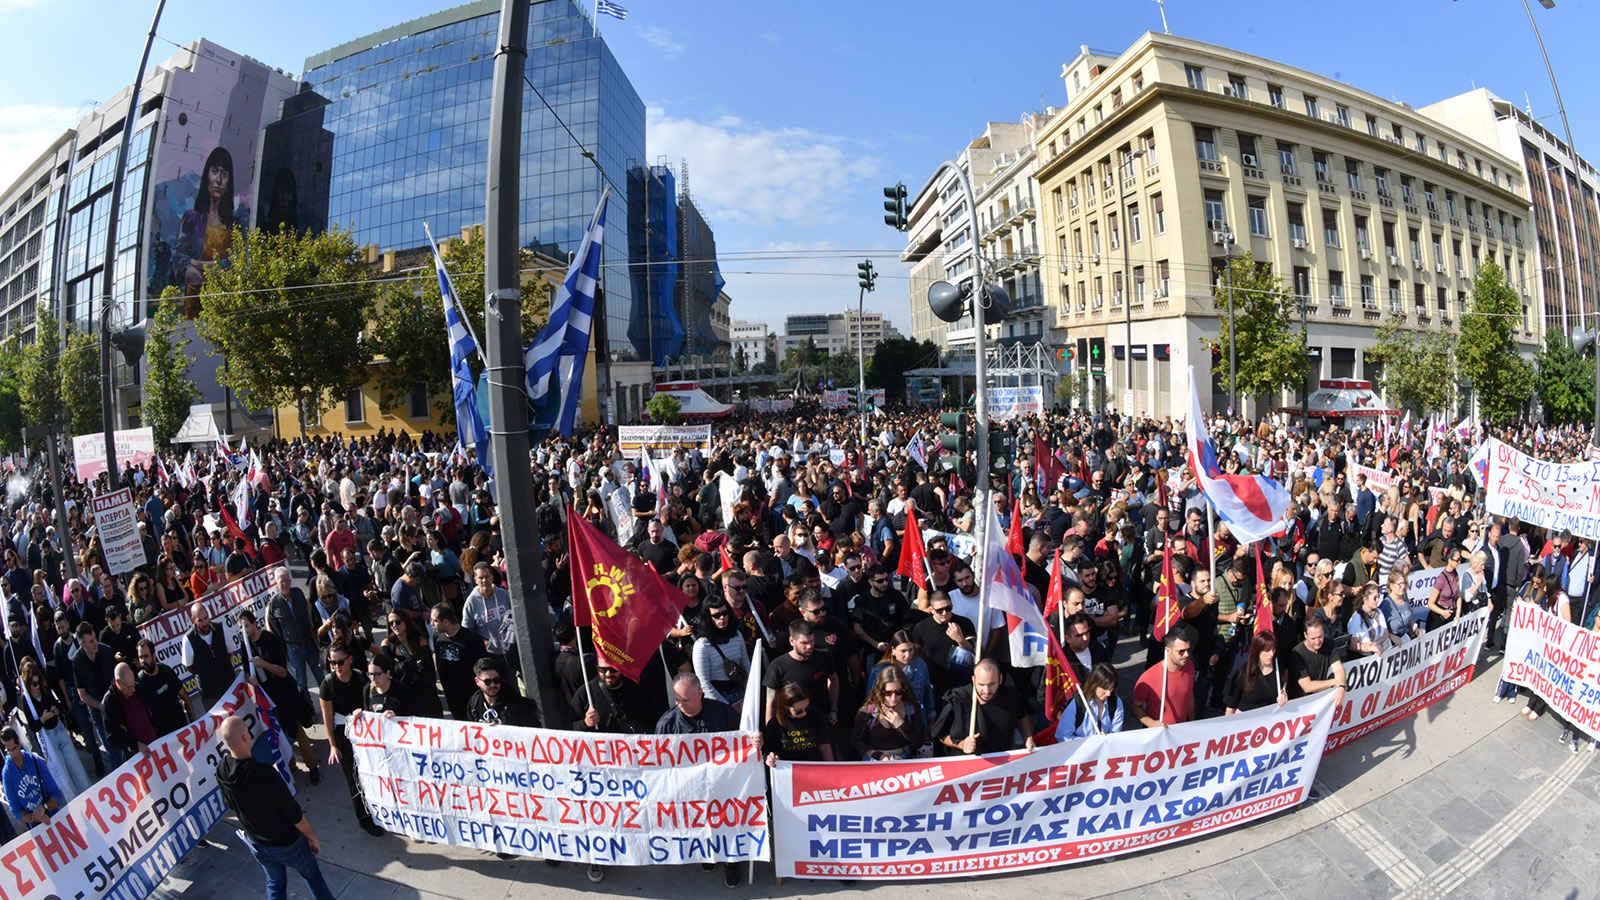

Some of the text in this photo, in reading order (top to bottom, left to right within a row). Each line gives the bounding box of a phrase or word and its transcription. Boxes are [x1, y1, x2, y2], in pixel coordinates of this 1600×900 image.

[1523, 457, 1551, 480] ΣΤΟ
[96, 492, 129, 512] ΠΑΜΕ
[100, 507, 130, 525] ΑΠΕΡΓΙΑ
[1503, 499, 1545, 526] ΚΛΑΔΙΚΟ
[1415, 576, 1437, 589] ΦΤΩ
[1513, 604, 1536, 631] ΝΑ
[1537, 611, 1567, 645] ΜΗΝ
[1342, 662, 1383, 693] ΟΧΟΙ
[1386, 645, 1421, 680] ΤΕΡΜΑ
[1423, 641, 1435, 661] ΤΑ
[1360, 688, 1381, 719] ΟΙ
[1383, 662, 1441, 711] ΑΝΑΓΚΕΣ
[1442, 647, 1467, 677] ΜΑΣ
[1524, 648, 1576, 696] ΑΠΑΙΤΟΥΜΕ
[1543, 642, 1587, 680] ΝΟΜΟΣ
[1507, 661, 1552, 699] ΣΩΜΑΤΕΙΟ
[1552, 688, 1600, 731] ΕΡΓΑΖΟΜΕ
[353, 716, 386, 748] ΟΧΙ
[397, 720, 442, 749] ΣΤΗ
[459, 725, 528, 760] 13ΩΡΗ
[933, 714, 1317, 806] ΑΥΞΗΣΕΙΣ ΣΤΟΥΣ ΜΙΣΘΟΥΣ
[378, 776, 766, 829] ΜΕ ΑΥΞΗΣΕΙΣ ΣΤΟΥΣ ΜΙΣΘΟΥΣ
[799, 765, 945, 804] ΔΙΕΚΔΙΚΟΥΜΕ
[808, 811, 953, 833] ΜΕΙΩΣΗ
[963, 801, 1036, 829] ΤΟΥ
[1040, 775, 1177, 816] ΧΡΟΝΟΥ
[1181, 741, 1309, 792] ΕΡΓΑΣΙΑΣ
[1, 813, 88, 897] ΣΤΗΝ
[85, 743, 178, 835] 13ΩΡΗ
[84, 782, 190, 893] 5ΗΜΕΡΟ
[372, 803, 448, 840] ΣΩΜΑΤΕΙΟ
[650, 830, 766, 863] STANLEY
[806, 862, 926, 876] ΣΥΝΔΙΚΑΤΟ
[930, 846, 1062, 873] ΕΠΙΣΙΤΙΣΜΟΥ
[1077, 826, 1180, 856] ΤΟΥΡΙΣΜΟΥ
[1190, 791, 1297, 833] ΞΕΝΟΔΟΧΕΙΩΝ
[809, 766, 1302, 859] ΜΕΤΡΑ ΥΓΕΙΑΣ ΚΑΙ ΑΣΦΑΛΕΙΑΣ
[141, 814, 201, 887] ΚΕΝΤΡΟ
